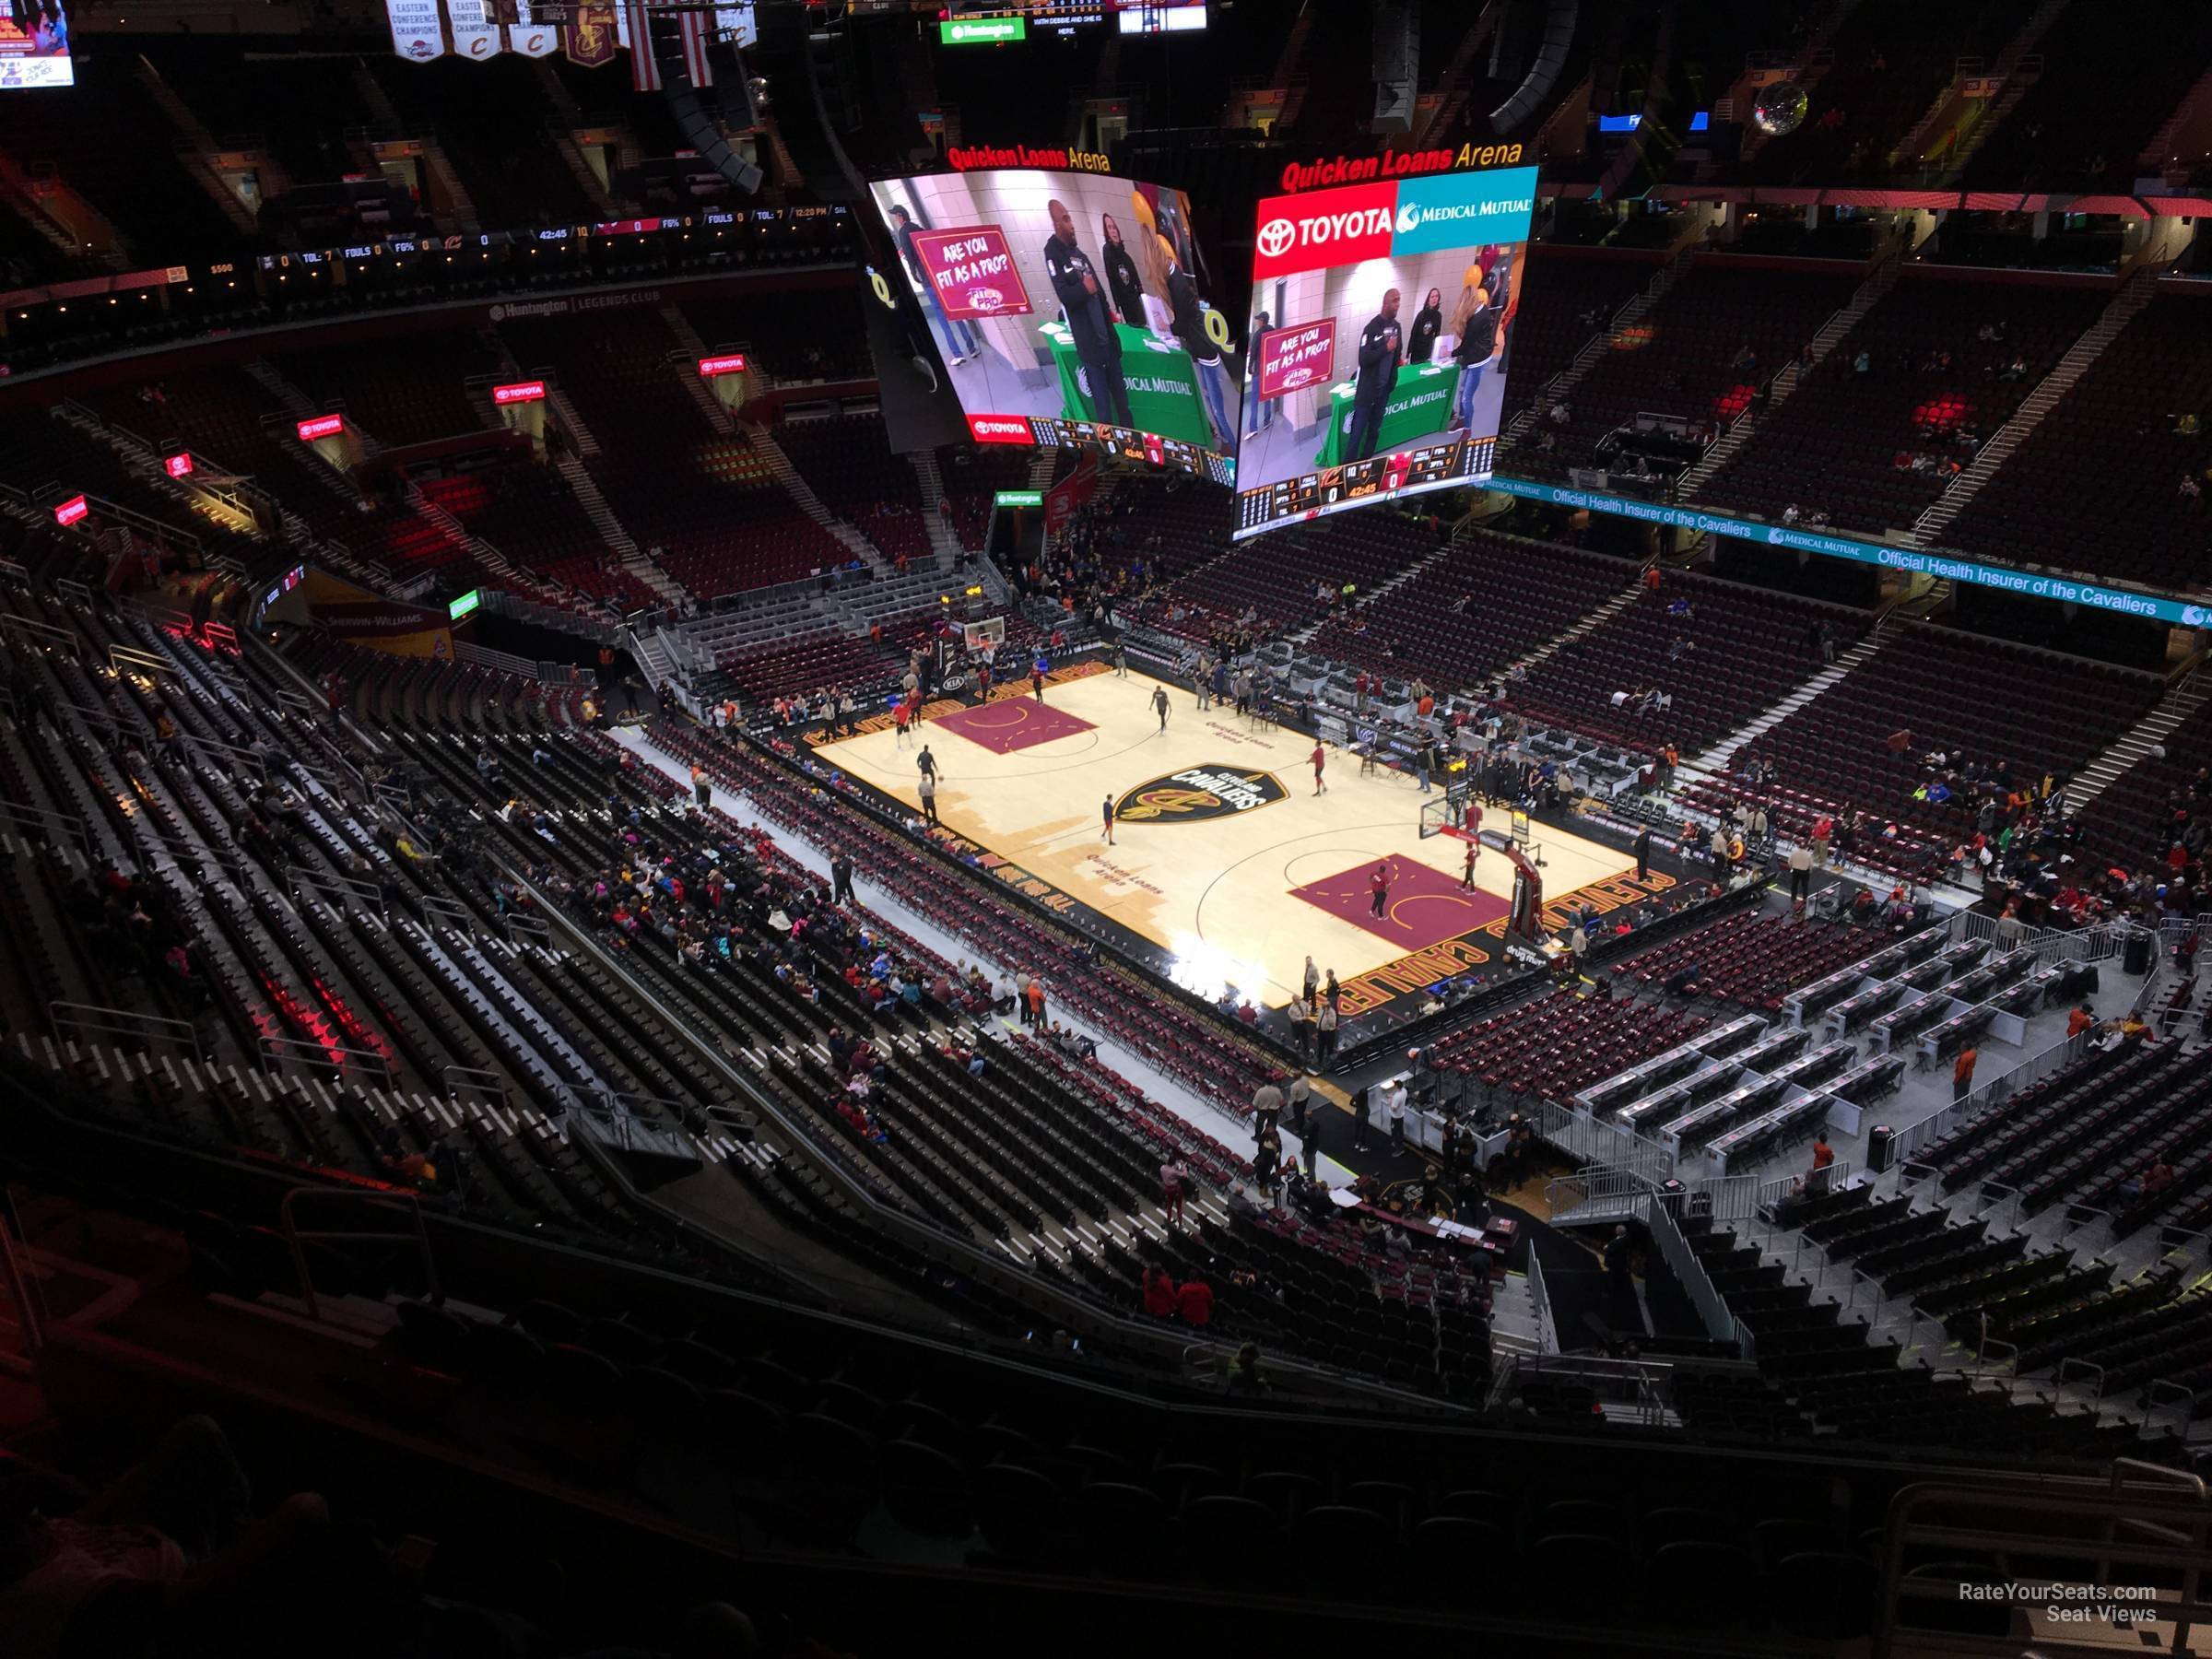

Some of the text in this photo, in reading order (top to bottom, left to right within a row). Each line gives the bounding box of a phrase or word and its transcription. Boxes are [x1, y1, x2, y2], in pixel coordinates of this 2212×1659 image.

[395, 3, 429, 13] EASTERN
[456, 2, 481, 11] EASTER
[392, 13, 438, 24] CONFERENCE
[395, 26, 438, 35] CHAMPIONS
[948, 145, 1111, 172] Quicken Loans Arena
[1281, 142, 1524, 193] Quicken Loans Arena
[708, 213, 733, 224] FOULS
[777, 209, 783, 220] 7
[1421, 205, 1477, 223] MEDICAL
[634, 221, 641, 231] 0
[663, 218, 680, 229] FG%
[1298, 206, 1393, 246] TOYOTA
[480, 234, 488, 246] 0
[539, 229, 568, 240] 42:45
[345, 244, 382, 258] FOULS 0
[394, 241, 429, 253] FG% 0
[942, 237, 989, 264] ARE YOU
[280, 255, 289, 267] 0
[324, 251, 333, 261] 7
[935, 253, 1008, 289] FIT AS A PRO?
[871, 273, 896, 309] Q
[506, 290, 661, 317] Huntington LEGENDS CLUB
[1204, 309, 1236, 354] Q
[1279, 328, 1319, 354] ARE YOU
[712, 359, 743, 370] TOYOTA
[1265, 359, 1281, 377] FIT
[1281, 353, 1295, 369] AS
[1295, 349, 1303, 362] A
[1304, 338, 1330, 359] PRO?
[509, 385, 543, 397] TOYOTA
[1151, 377, 1193, 395] MUTUAL
[1409, 389, 1448, 408] MUTUAL
[311, 419, 340, 432] TOYOTA
[988, 421, 1026, 434] TOYOTA
[1107, 441, 1117, 454] 0
[1150, 449, 1159, 463] 0
[1389, 474, 1398, 488] 0
[1487, 480, 1513, 490] MEDICAL
[1328, 488, 1337, 502] 0
[1348, 483, 1376, 498] 42:45
[1006, 494, 1041, 504] Huntington
[1552, 488, 1751, 537] Official Health Insurer of the Cavaliers
[1784, 533, 1823, 549] MEDICAL
[1877, 549, 2157, 616] Official Health Insurer of the Cavaliers
[947, 678, 961, 688] KIA
[1206, 721, 1275, 749] Quicken Loans
[1212, 731, 1243, 745] Arena
[1217, 771, 1264, 793] CLEVELAND
[1171, 769, 1267, 810] CAVALIERS
[1086, 853, 1164, 895] Quicken Loans
[1092, 868, 1126, 887] Arena
[1506, 945, 1526, 962] drug
